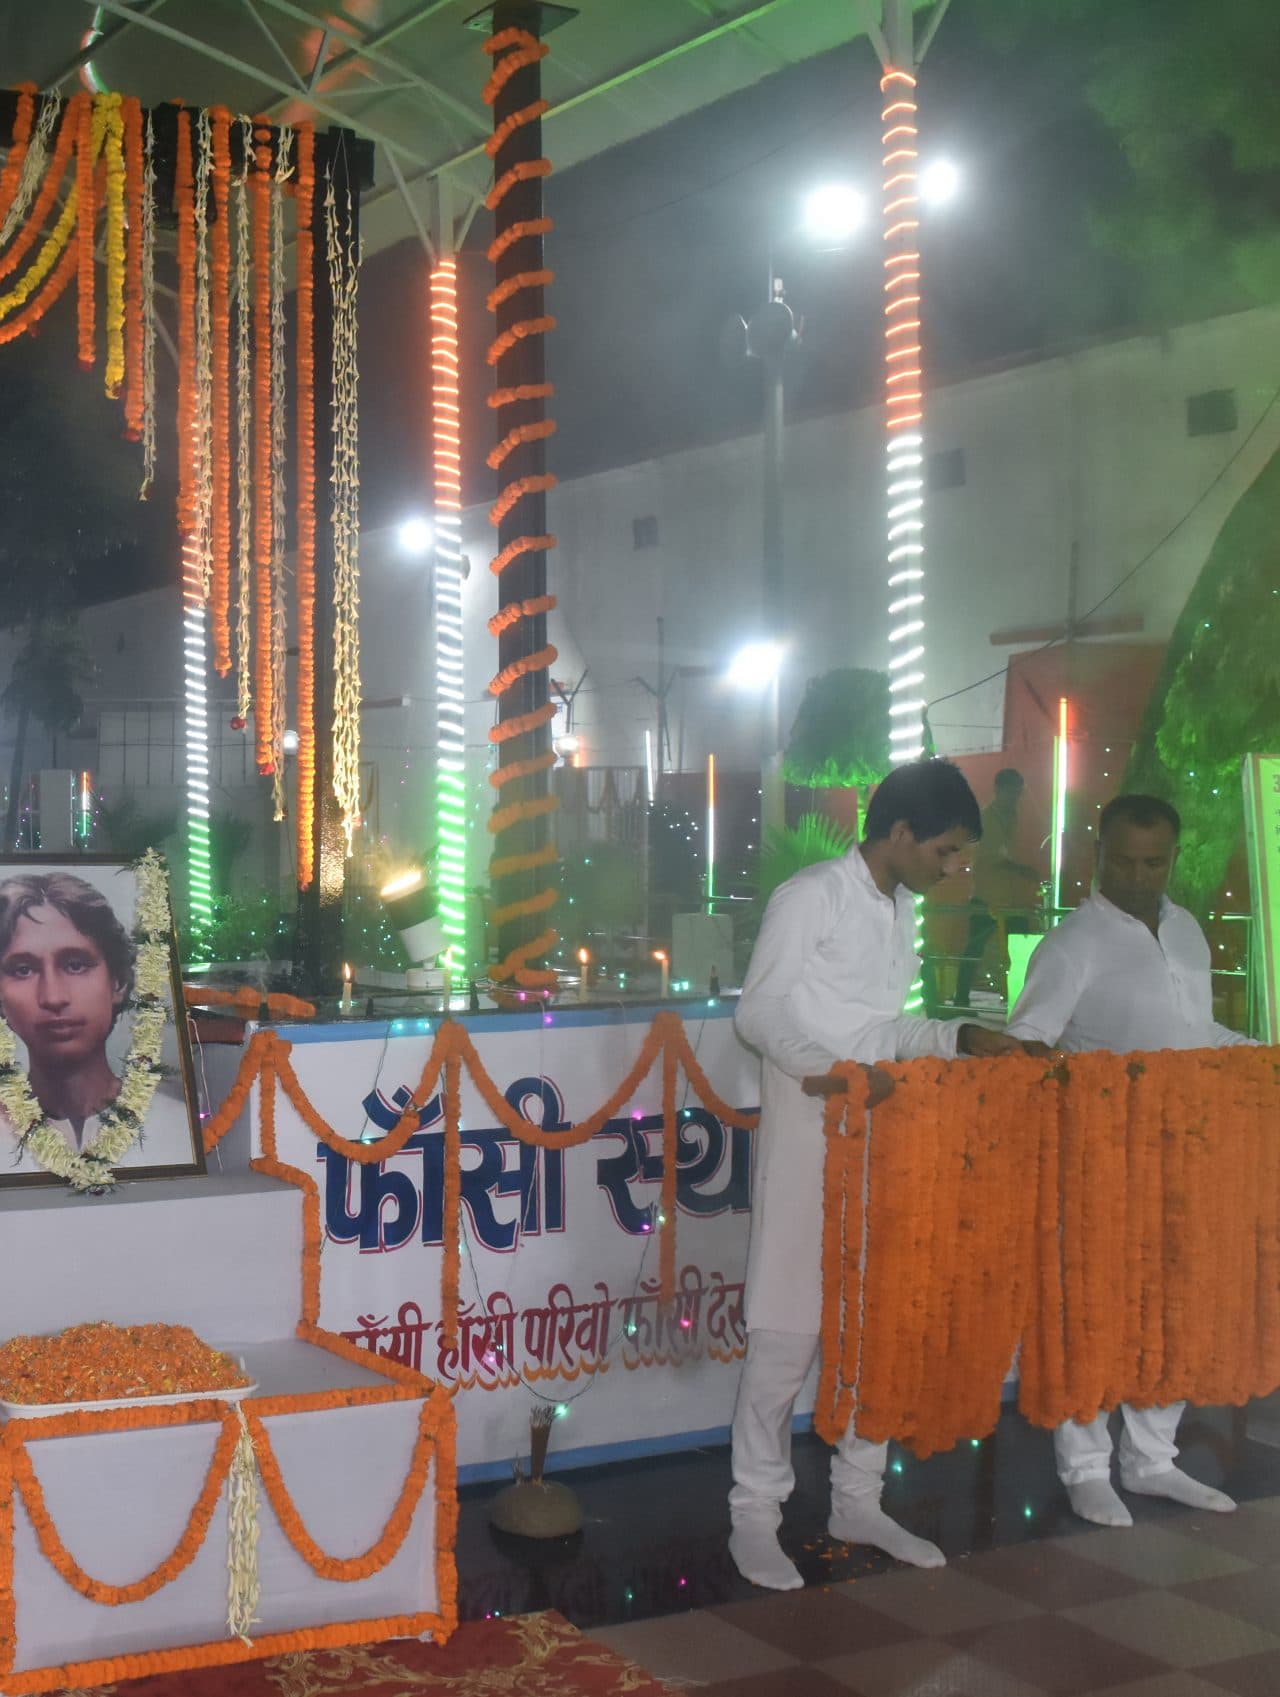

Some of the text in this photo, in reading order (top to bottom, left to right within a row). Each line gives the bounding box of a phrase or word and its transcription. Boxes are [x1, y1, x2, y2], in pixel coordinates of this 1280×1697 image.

[316, 1075, 760, 1254] फाँसी स्थ
[340, 1301, 434, 1372] ाँसी
